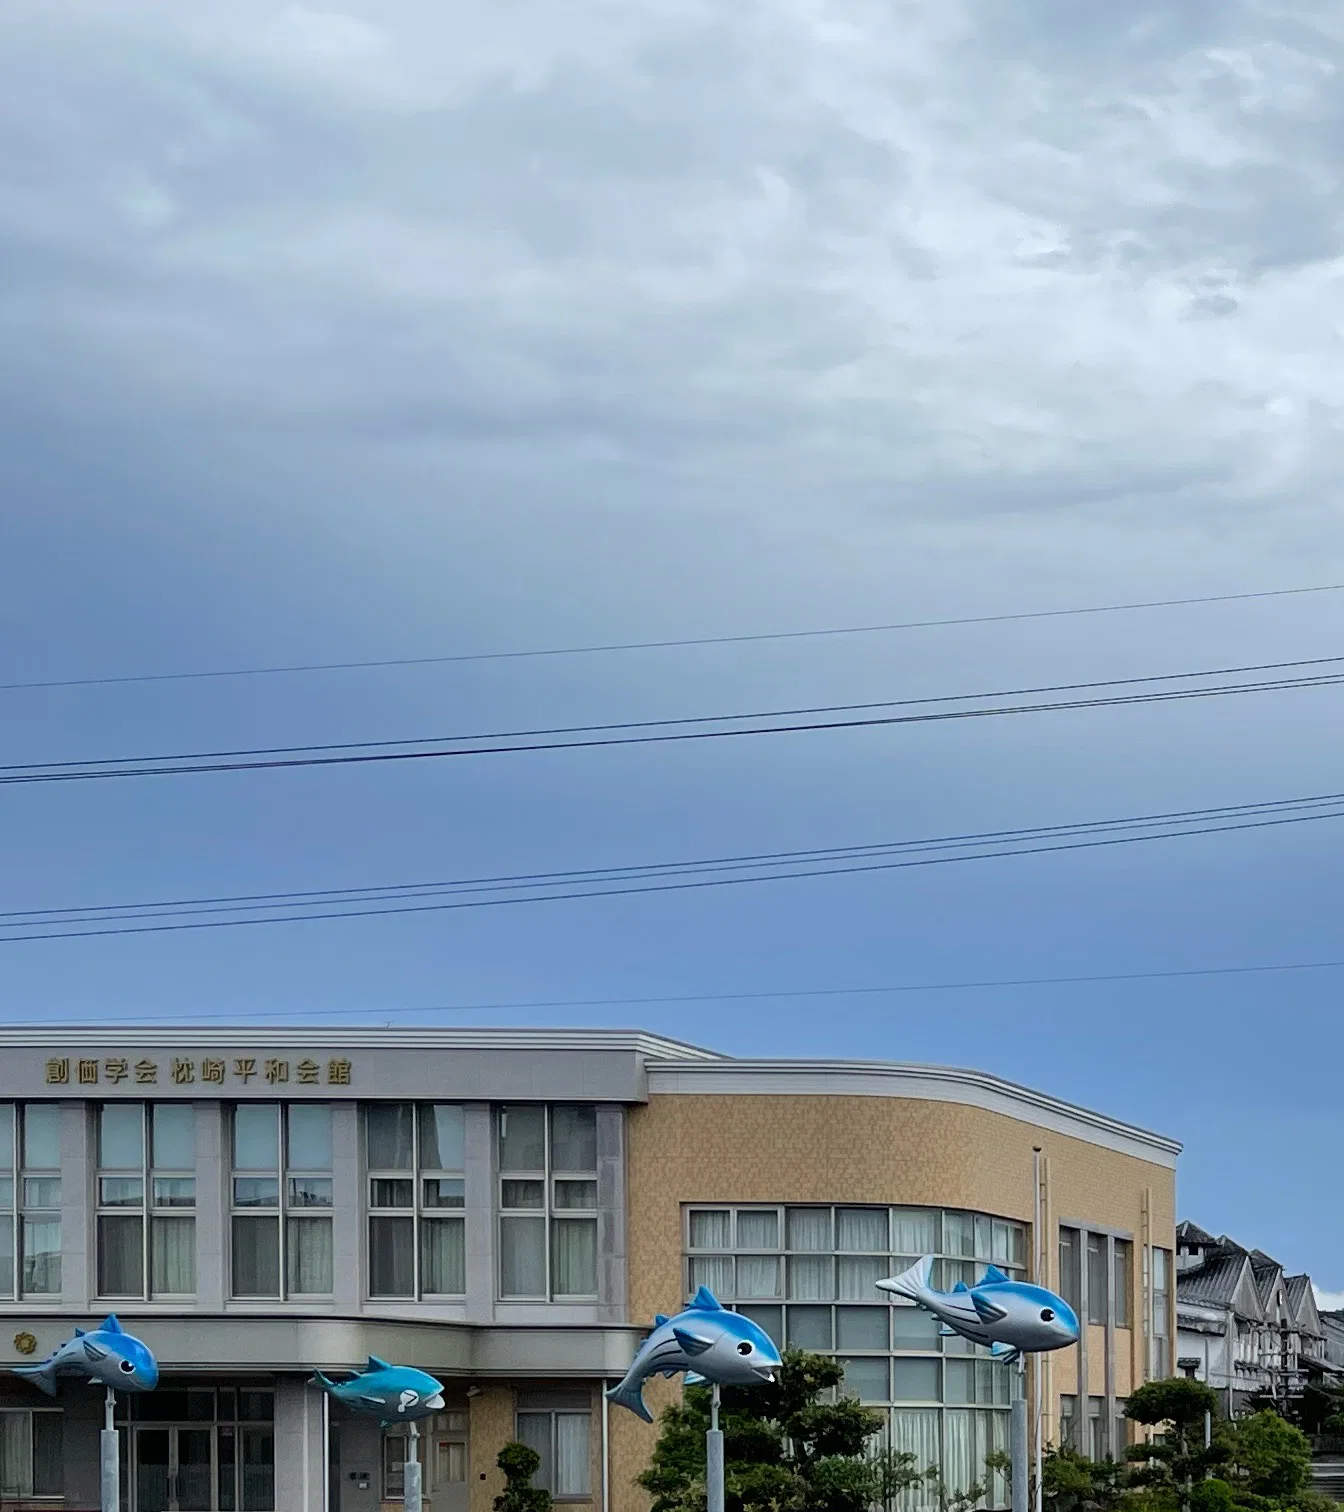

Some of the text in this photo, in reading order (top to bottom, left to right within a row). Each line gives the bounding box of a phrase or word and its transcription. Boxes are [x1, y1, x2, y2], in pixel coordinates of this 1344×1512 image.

[46, 1057, 352, 1085] 創価学会 枕崎平和会館
